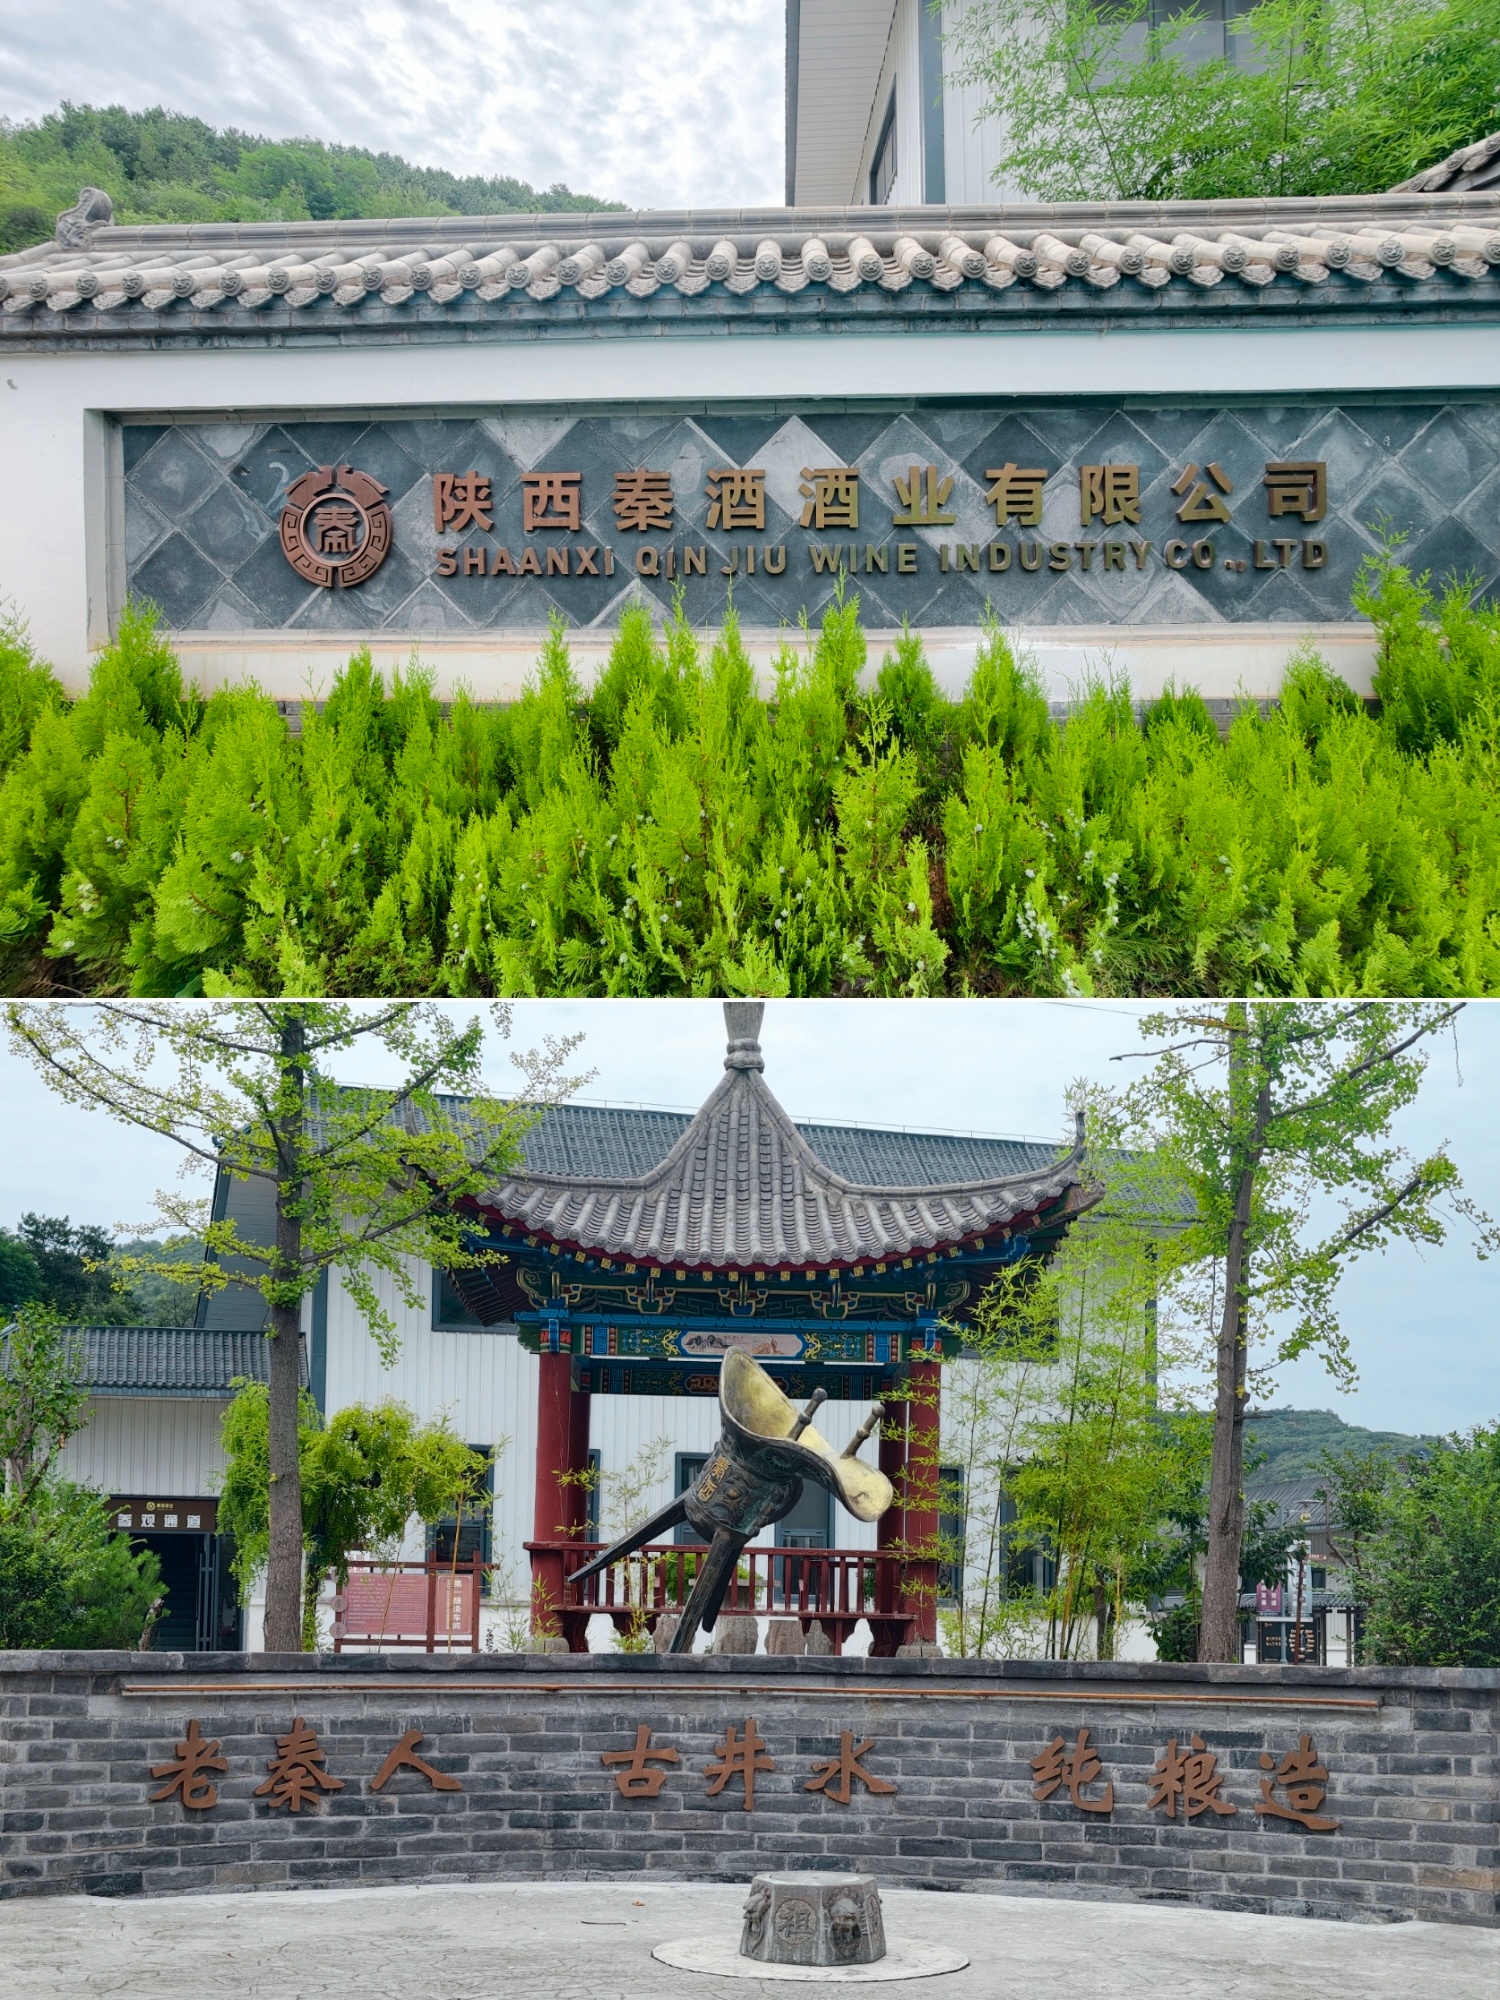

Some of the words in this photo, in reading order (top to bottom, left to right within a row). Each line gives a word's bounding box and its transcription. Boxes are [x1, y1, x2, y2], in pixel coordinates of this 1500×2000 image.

[432, 461, 1329, 533] 陕西秦酒酒业有限公司
[435, 545, 615, 577] SHAANXI
[634, 545, 707, 579] QIN
[720, 544, 787, 575] JIU
[808, 542, 918, 574] WINE
[939, 540, 1153, 573] INDUSTRY
[117, 1513, 201, 1529] 参观通道
[149, 1717, 463, 1813] 老秦人
[601, 1717, 897, 1811] 古井水
[1030, 1728, 1342, 1831] 纯粮造
